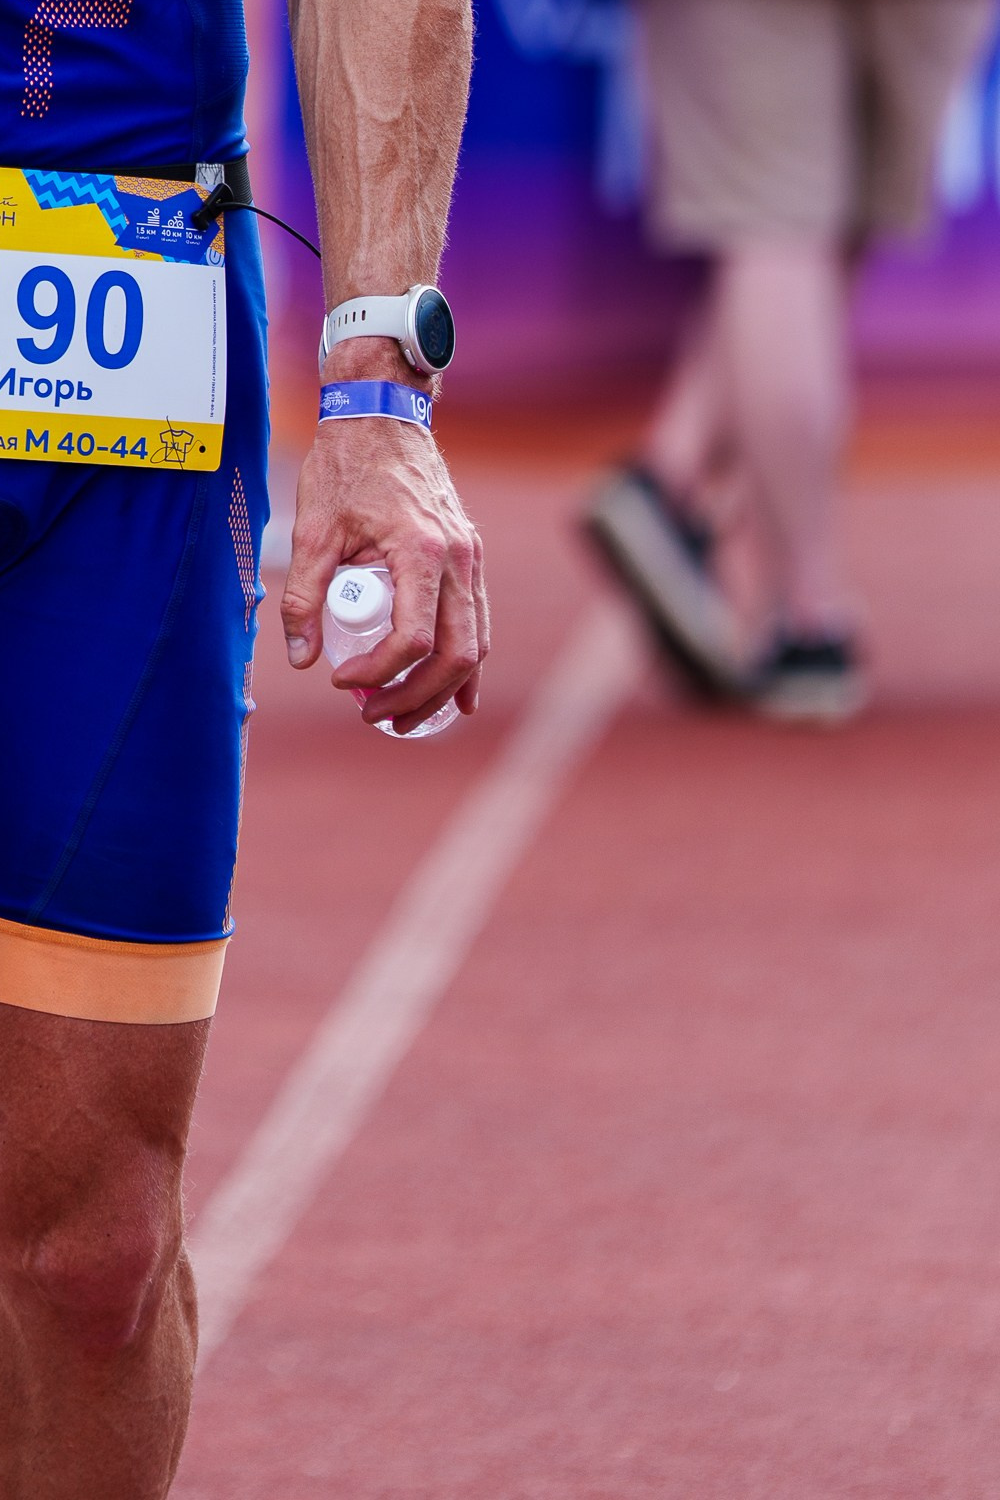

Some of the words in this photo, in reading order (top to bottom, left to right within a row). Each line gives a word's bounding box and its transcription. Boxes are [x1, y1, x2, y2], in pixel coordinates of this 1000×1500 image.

[161, 228, 172, 237] 40
[185, 231, 193, 240] 10
[410, 393, 433, 426] 190
[57, 432, 148, 460] 40-44
